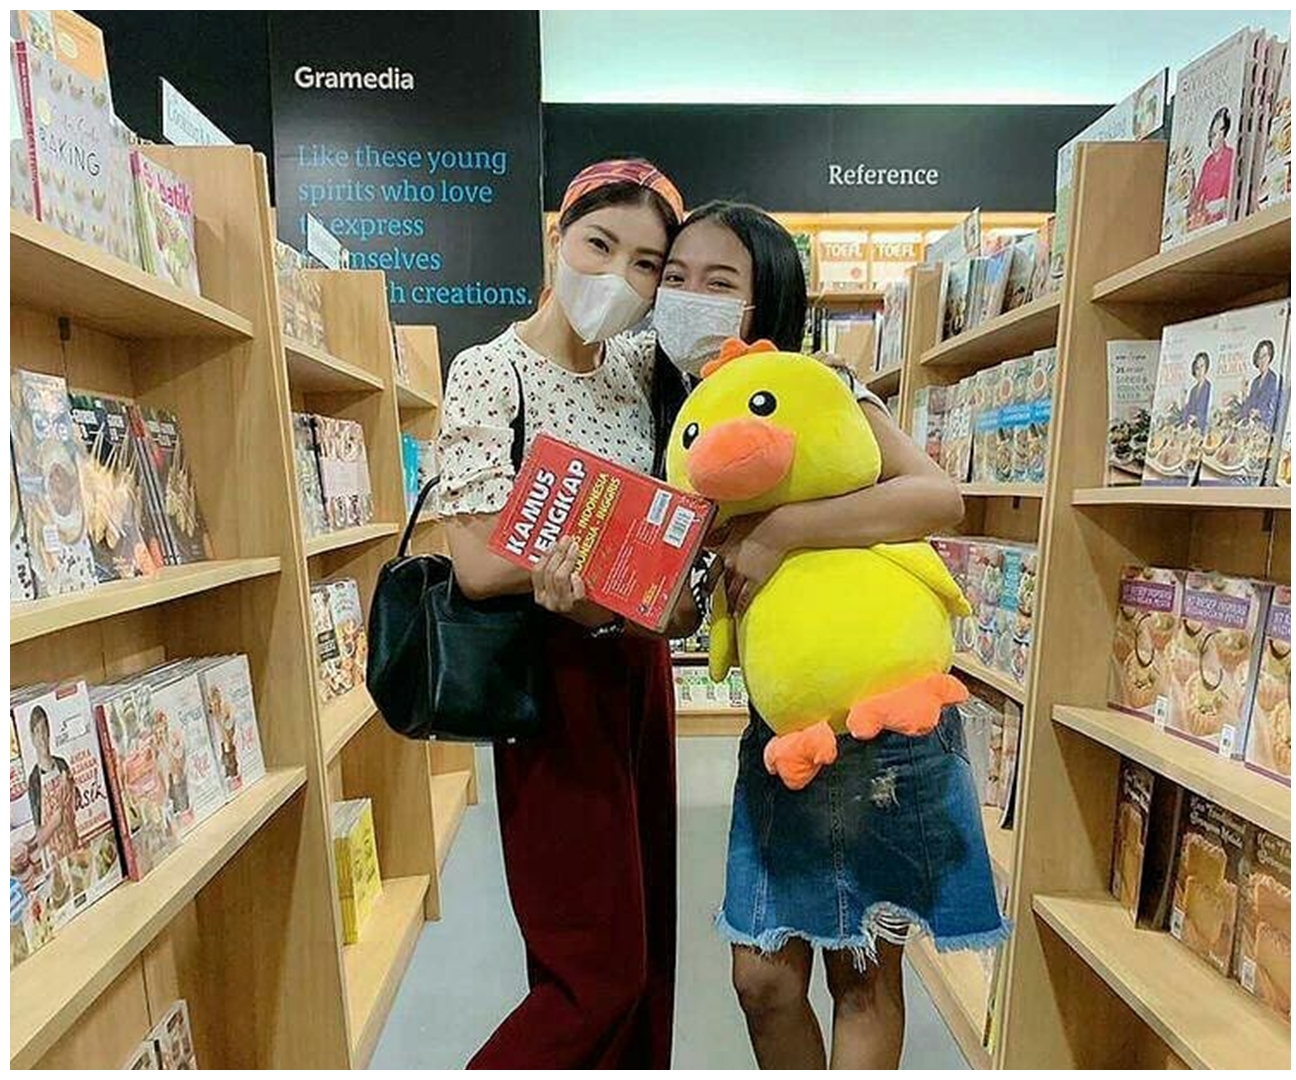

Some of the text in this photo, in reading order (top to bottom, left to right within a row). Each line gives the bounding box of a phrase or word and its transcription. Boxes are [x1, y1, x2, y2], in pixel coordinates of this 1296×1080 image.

[295, 66, 415, 90] Gramedia
[299, 145, 508, 174] Like these young
[828, 164, 939, 186] Reference
[298, 179, 493, 207] spirits who love
[330, 217, 425, 240] express
[412, 283, 533, 305] creations.
[505, 468, 556, 555] KAMUS
[577, 472, 609, 530] INDONESIA
[574, 526, 601, 575] DONESIA
[596, 476, 622, 520] INGGRIS
